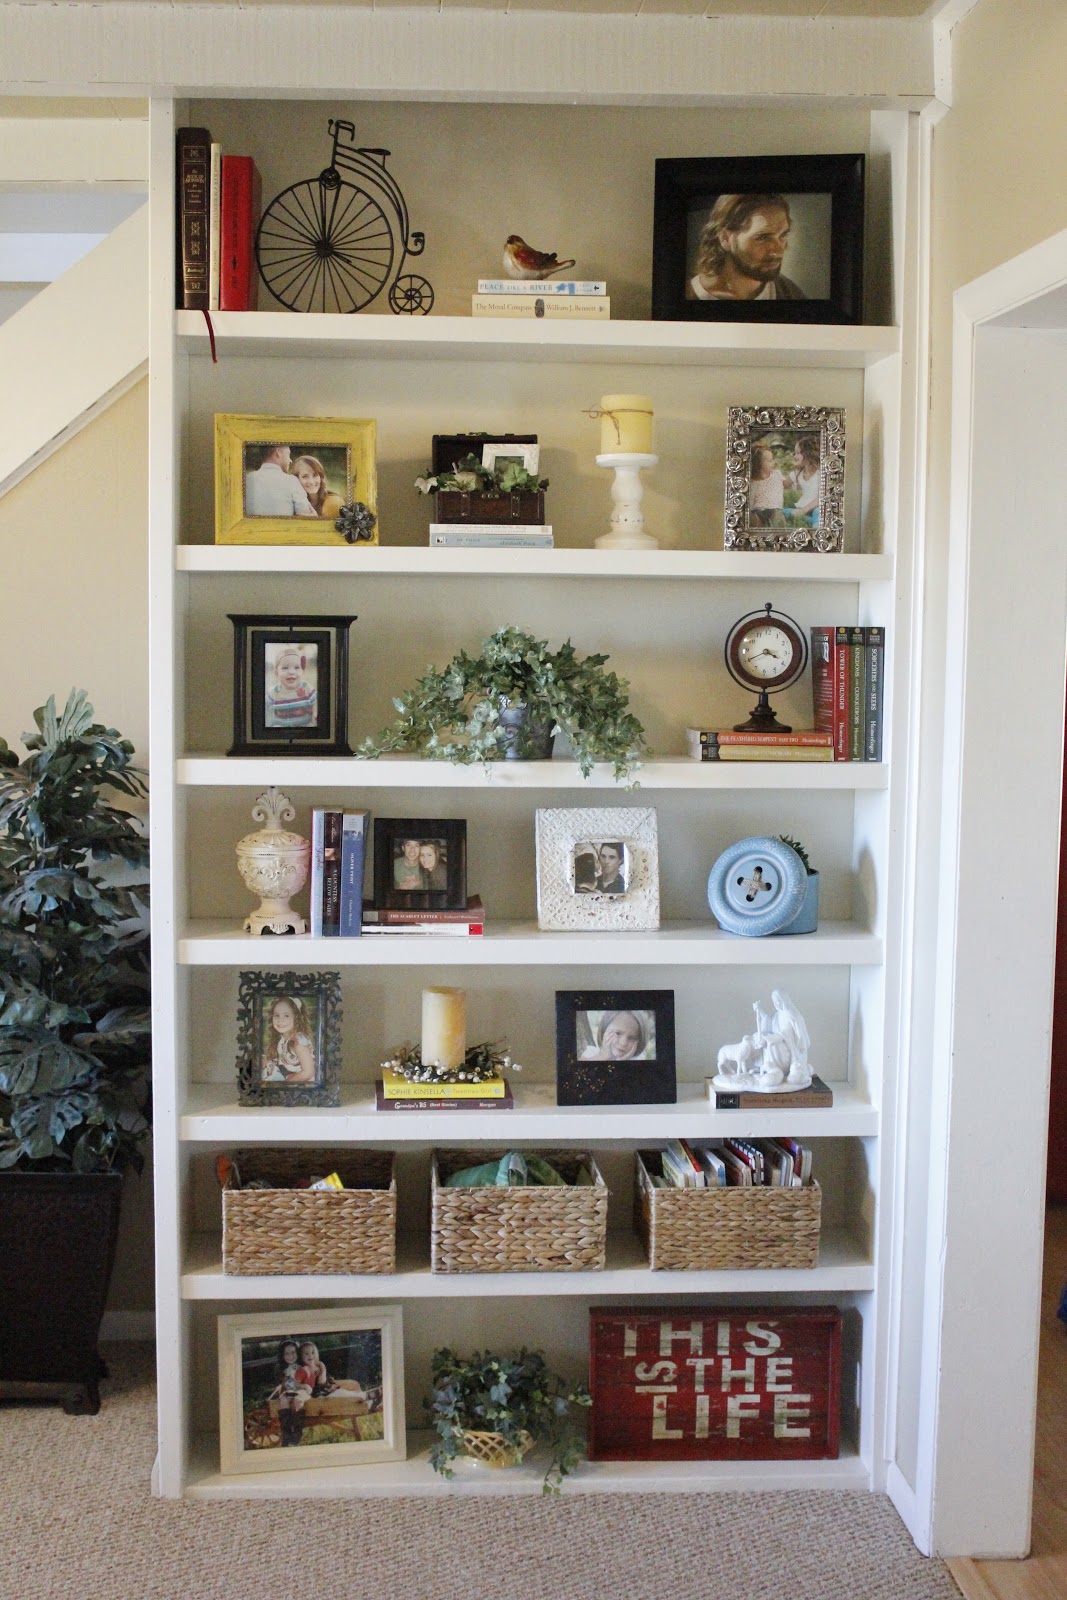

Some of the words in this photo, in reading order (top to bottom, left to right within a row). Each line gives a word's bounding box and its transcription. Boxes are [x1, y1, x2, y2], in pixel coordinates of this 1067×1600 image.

[840, 671, 845, 680] OF
[388, 1088, 411, 1096] SOPHIE
[613, 1320, 782, 1357] THIS
[635, 1360, 678, 1393] IS
[686, 1357, 793, 1393] THE
[652, 1394, 811, 1439] LIFE
